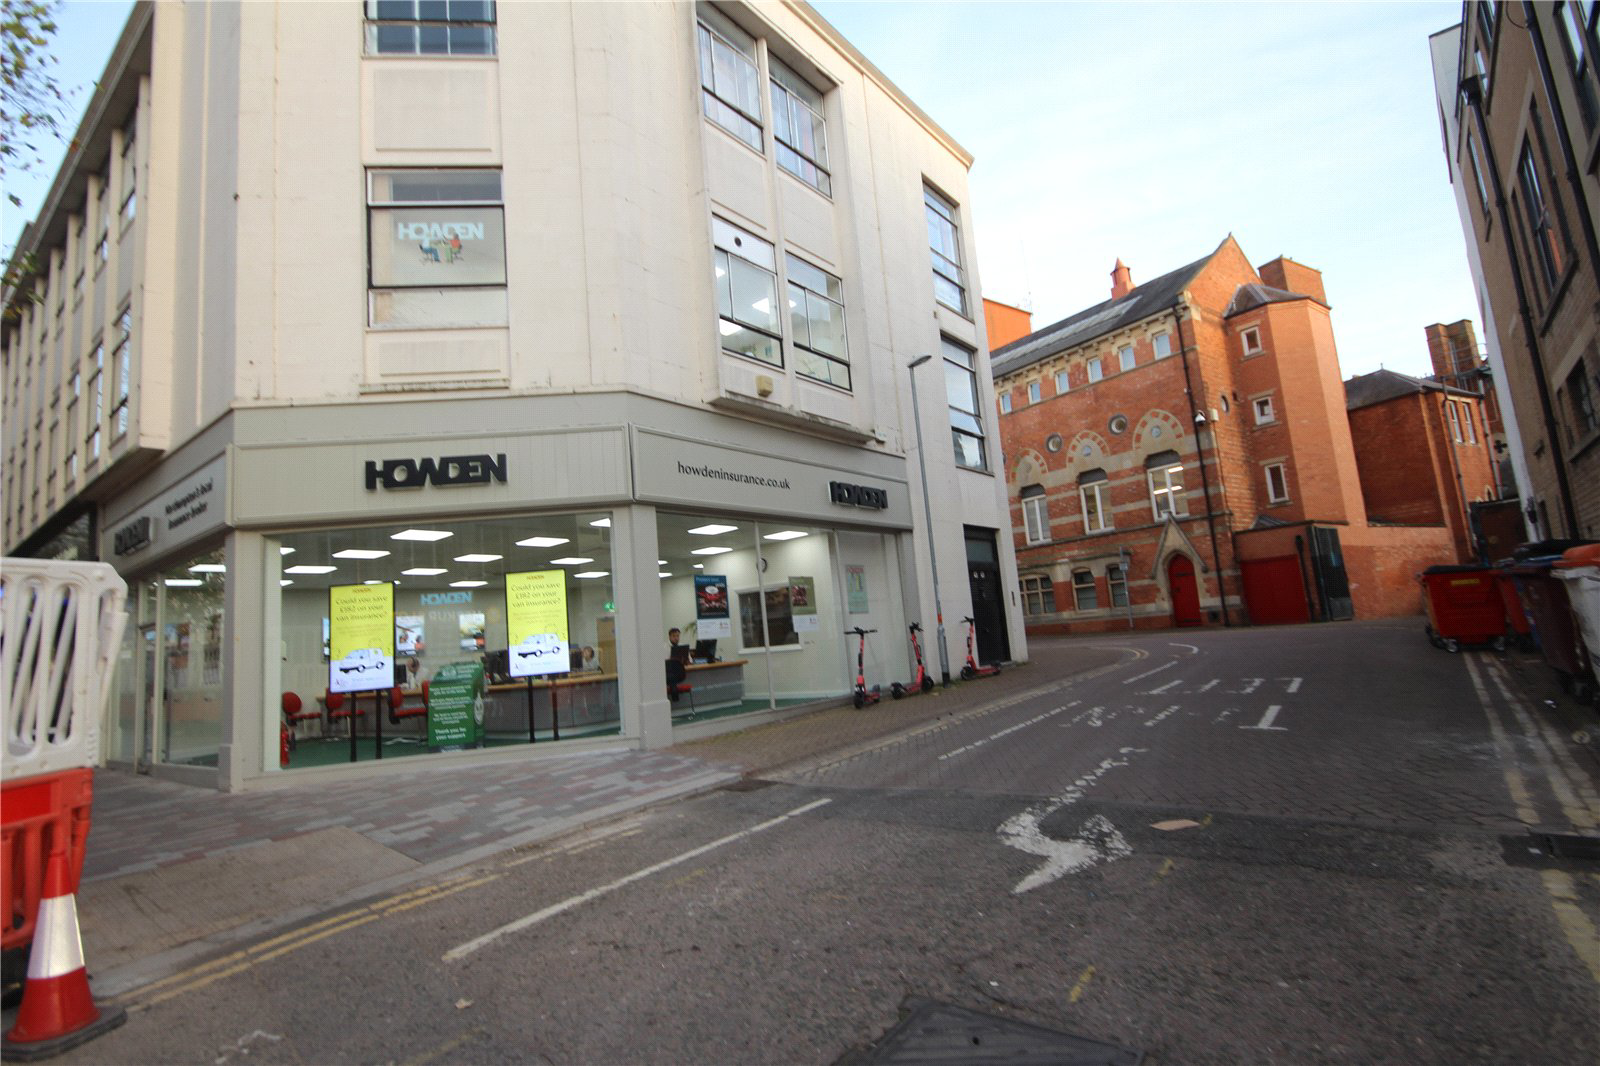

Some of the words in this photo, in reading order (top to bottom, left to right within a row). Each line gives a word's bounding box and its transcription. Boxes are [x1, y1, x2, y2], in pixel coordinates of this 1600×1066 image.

[398, 222, 485, 240] HOWDEN
[365, 453, 507, 489] HOWDEN
[677, 461, 791, 490] howdeninsurance.co.uk
[828, 480, 888, 509] HOWDEN
[420, 591, 472, 606] HOWDEN
